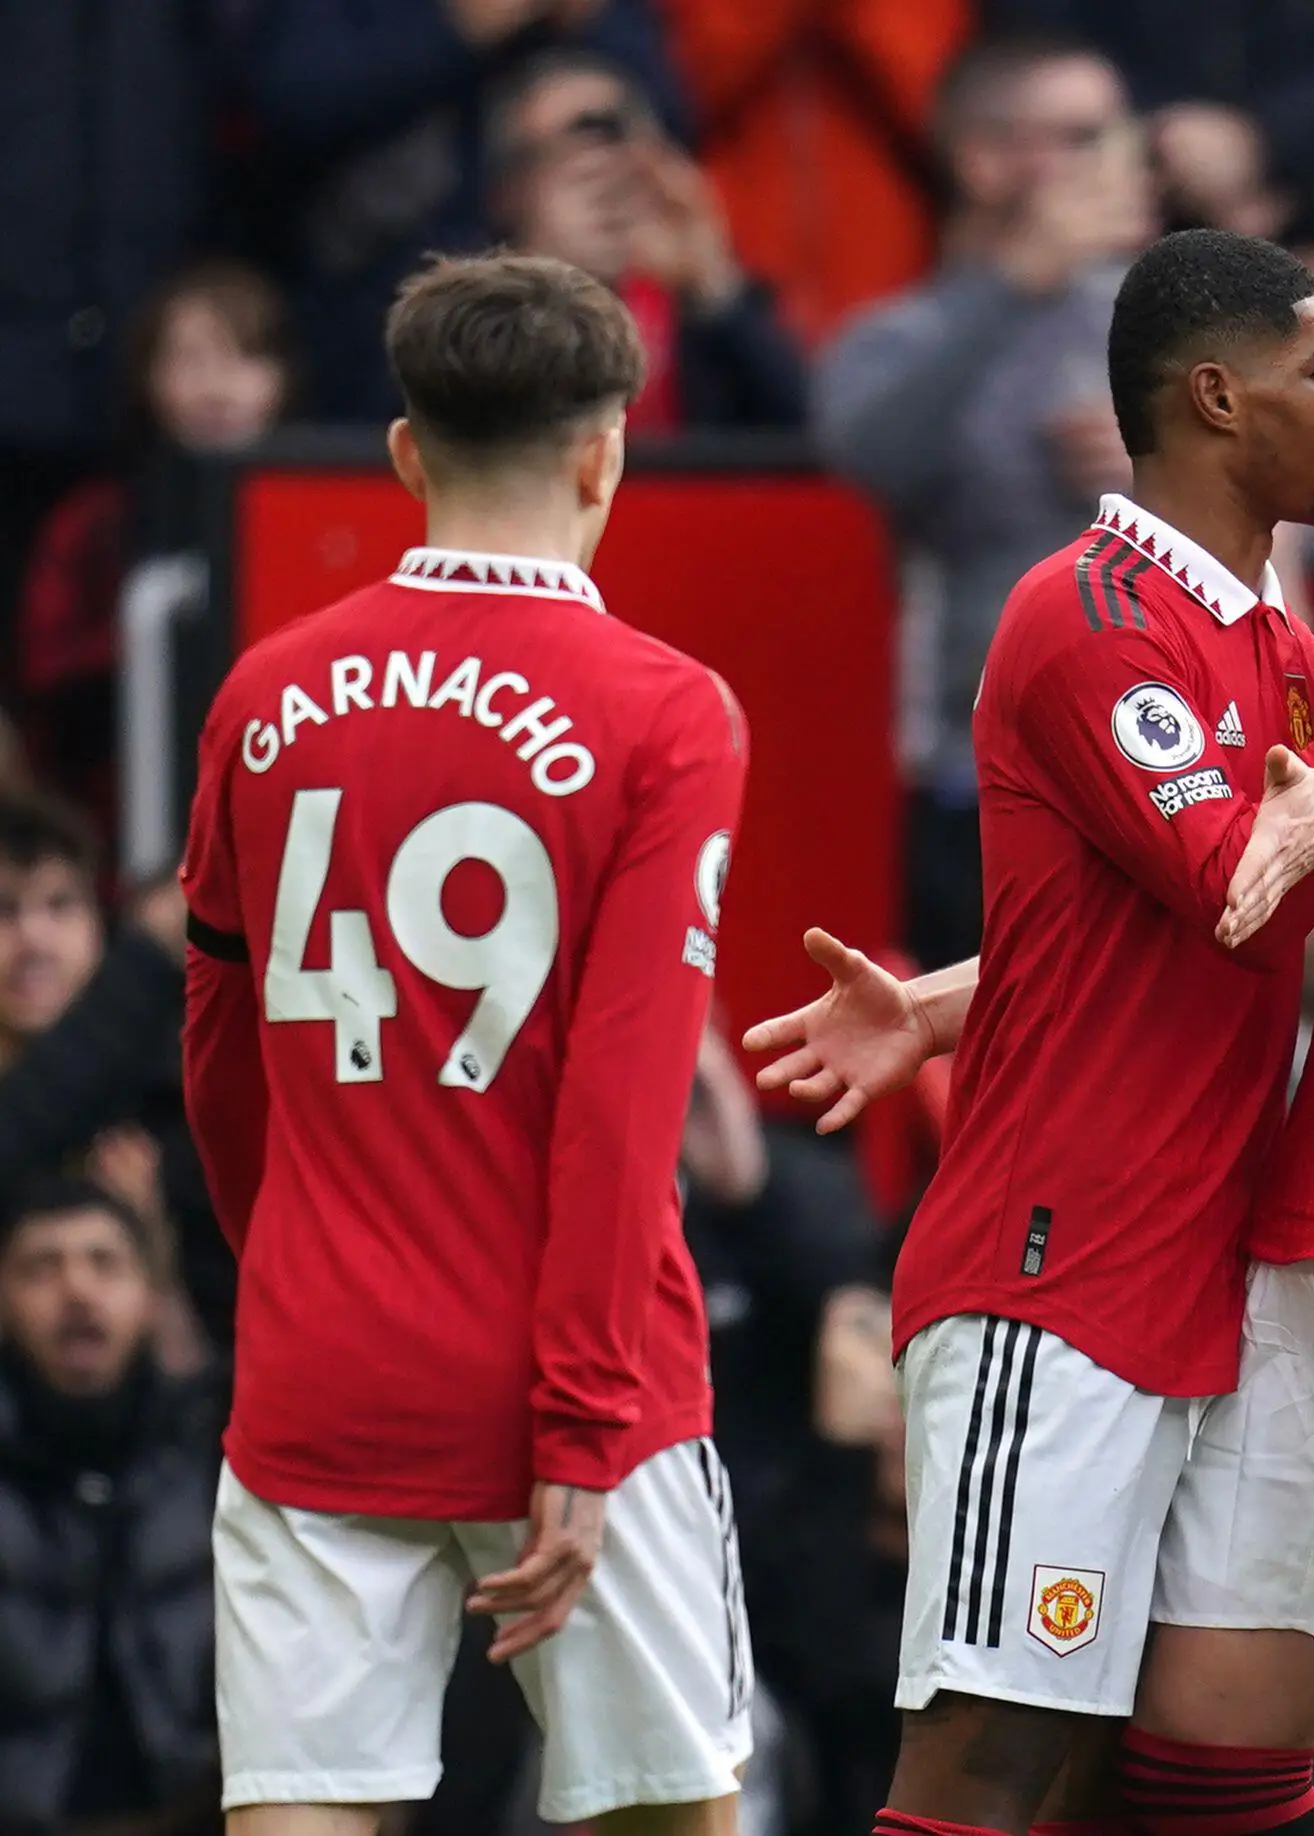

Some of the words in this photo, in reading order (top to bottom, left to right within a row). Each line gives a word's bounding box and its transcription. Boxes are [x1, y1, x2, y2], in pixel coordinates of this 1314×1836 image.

[242, 650, 596, 797] GARNACHO
[1160, 794, 1185, 820] for
[1177, 769, 1223, 792] room
[265, 787, 560, 1094] 49
